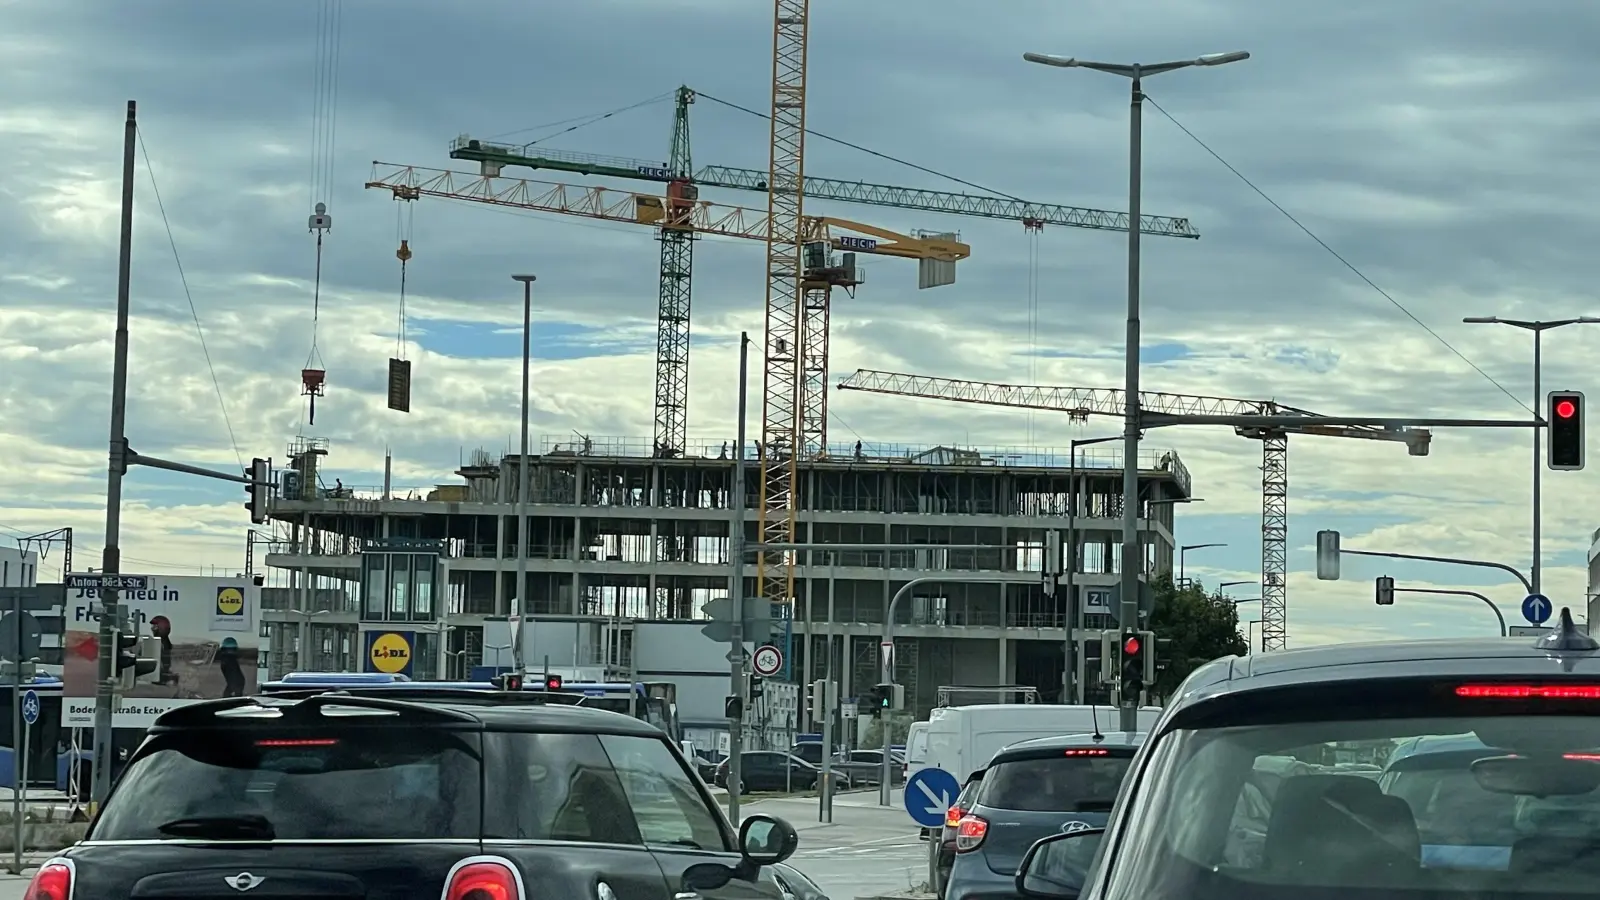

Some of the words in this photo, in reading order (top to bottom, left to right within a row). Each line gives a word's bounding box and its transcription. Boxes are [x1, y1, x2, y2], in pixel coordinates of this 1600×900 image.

[639, 167, 672, 177] ZECH
[842, 238, 875, 249] ZECH
[70, 577, 142, 588] Anton-Böck-Str.
[163, 585, 179, 601] in
[143, 706, 164, 715] Ecke
